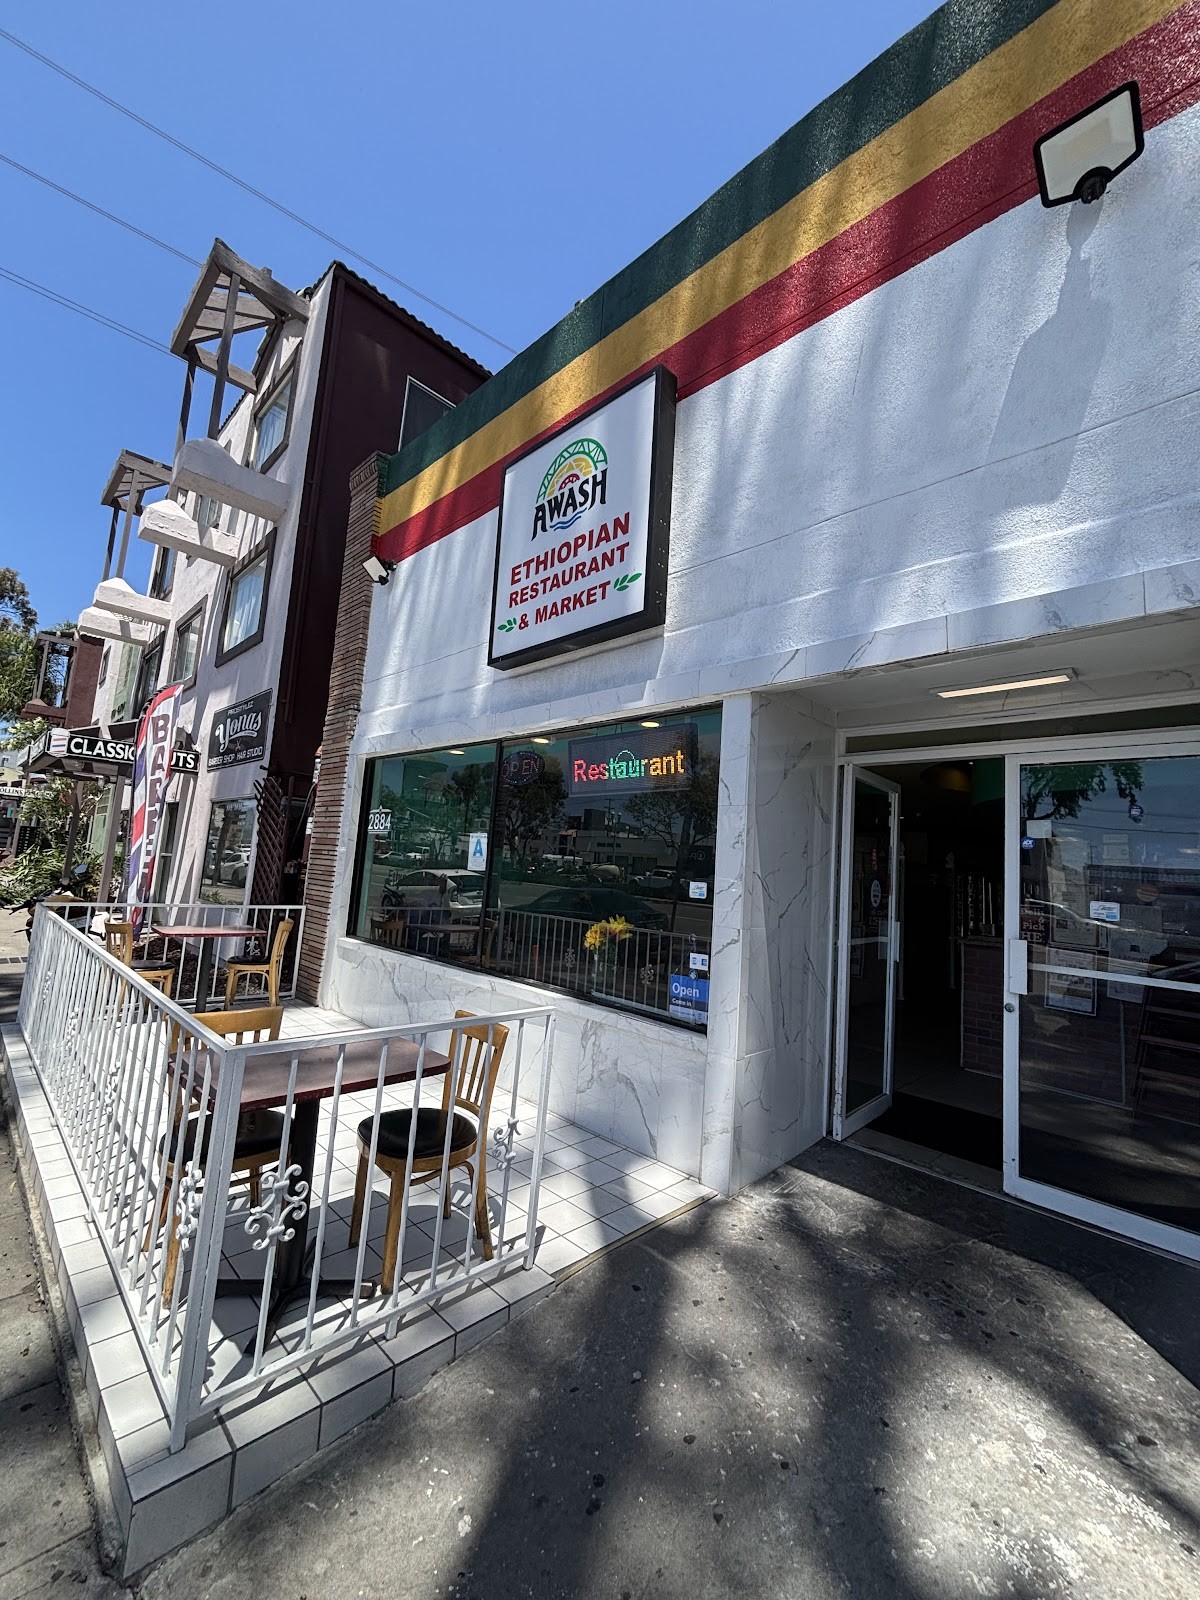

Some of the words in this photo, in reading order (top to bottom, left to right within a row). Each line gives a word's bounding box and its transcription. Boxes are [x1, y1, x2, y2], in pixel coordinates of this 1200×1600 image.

[531, 467, 608, 541] AWASH
[510, 512, 631, 586] ETHIOPIAN
[508, 542, 630, 608] RESTAURANT
[518, 613, 529, 630] &
[534, 580, 611, 625] MARKET
[170, 752, 195, 769] UTS
[247, 746, 263, 758] STUDIO
[502, 759, 540, 779] OPEN
[573, 750, 685, 783] Restaurant
[368, 813, 392, 830] 2884
[473, 838, 483, 856] A
[672, 982, 700, 998] Open
[672, 997, 686, 1006] Come
